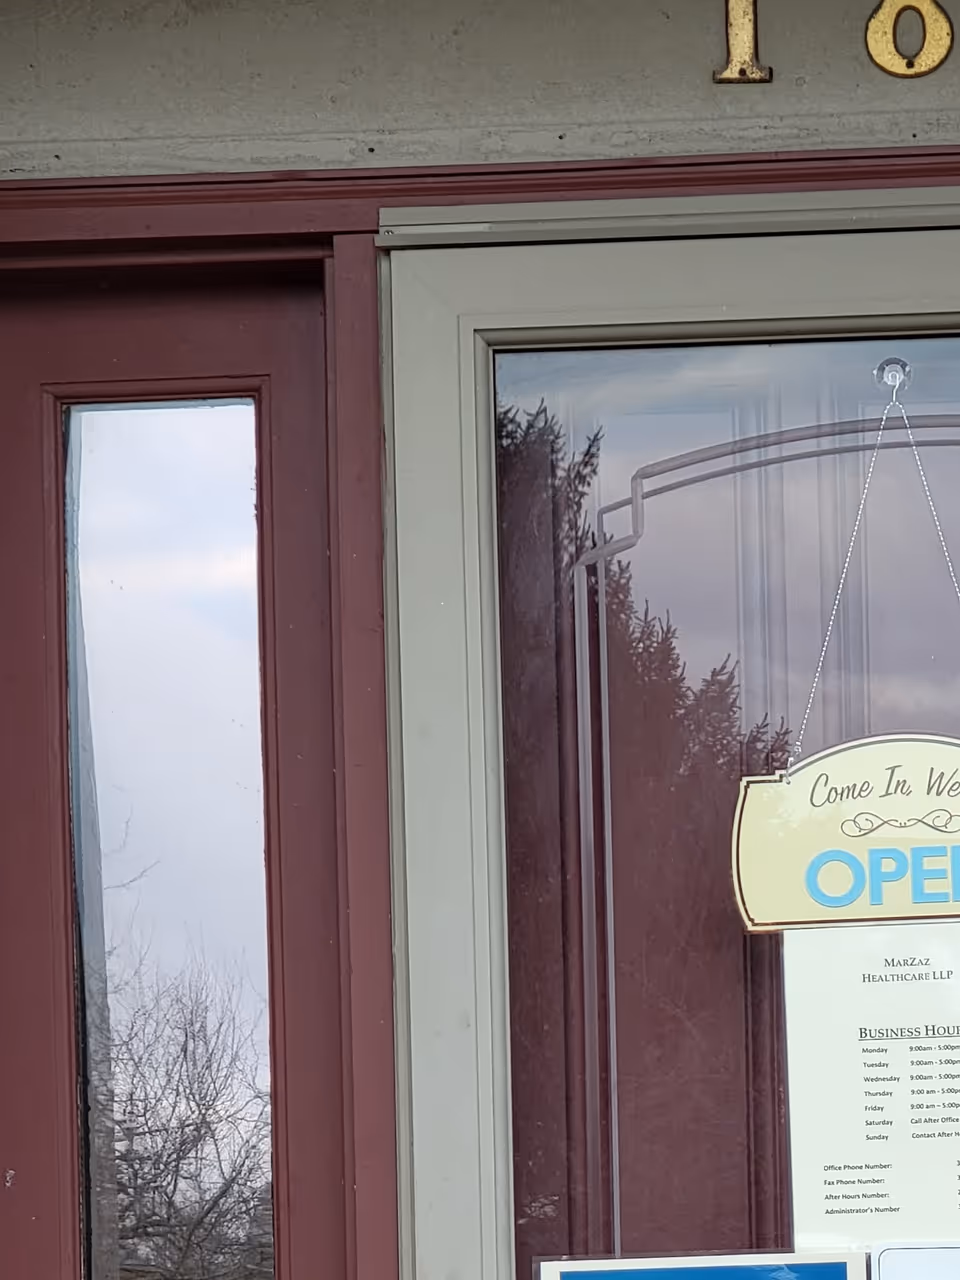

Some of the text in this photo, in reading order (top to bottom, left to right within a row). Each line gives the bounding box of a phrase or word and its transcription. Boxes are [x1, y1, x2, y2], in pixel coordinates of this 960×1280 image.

[809, 772, 873, 808] Come
[862, 970, 953, 982] HEALTHCARE LLP
[859, 1027, 921, 1038] BUSINESS
